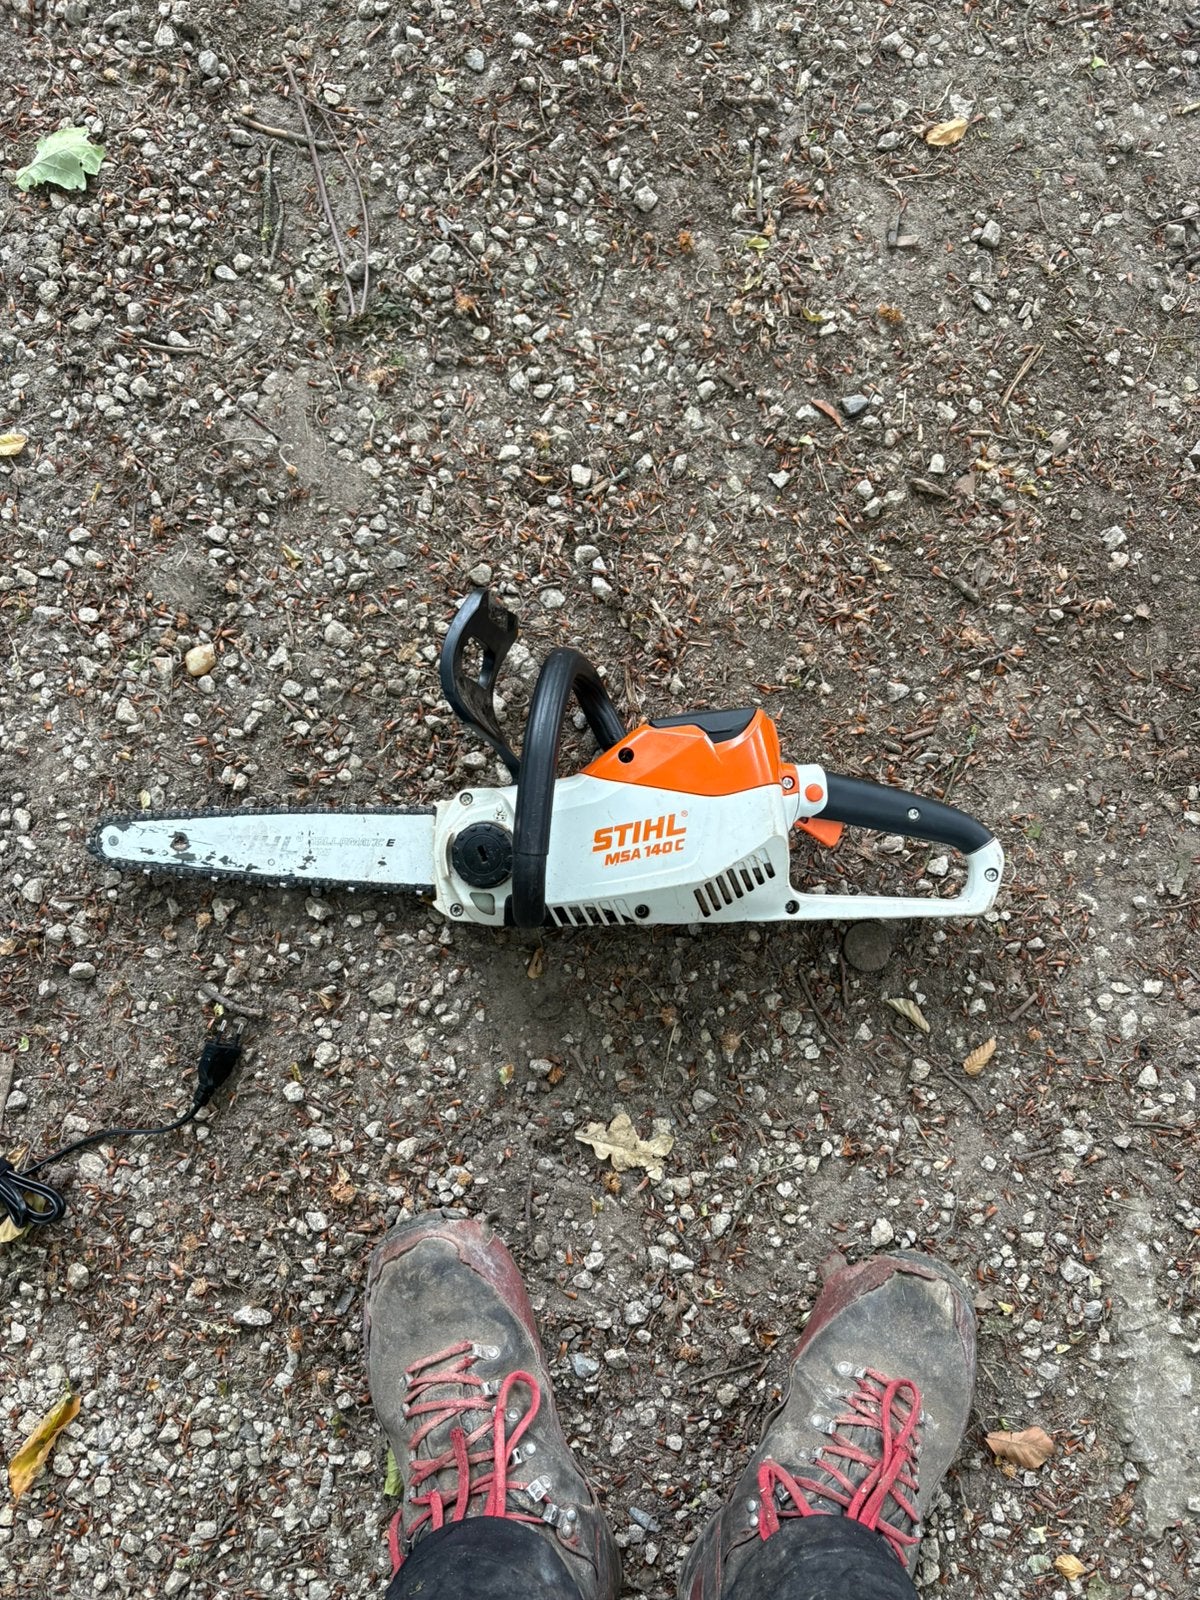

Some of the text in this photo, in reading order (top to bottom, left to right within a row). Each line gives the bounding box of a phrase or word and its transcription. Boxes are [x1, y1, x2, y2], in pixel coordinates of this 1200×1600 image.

[604, 838, 686, 866] MSA 140 C
